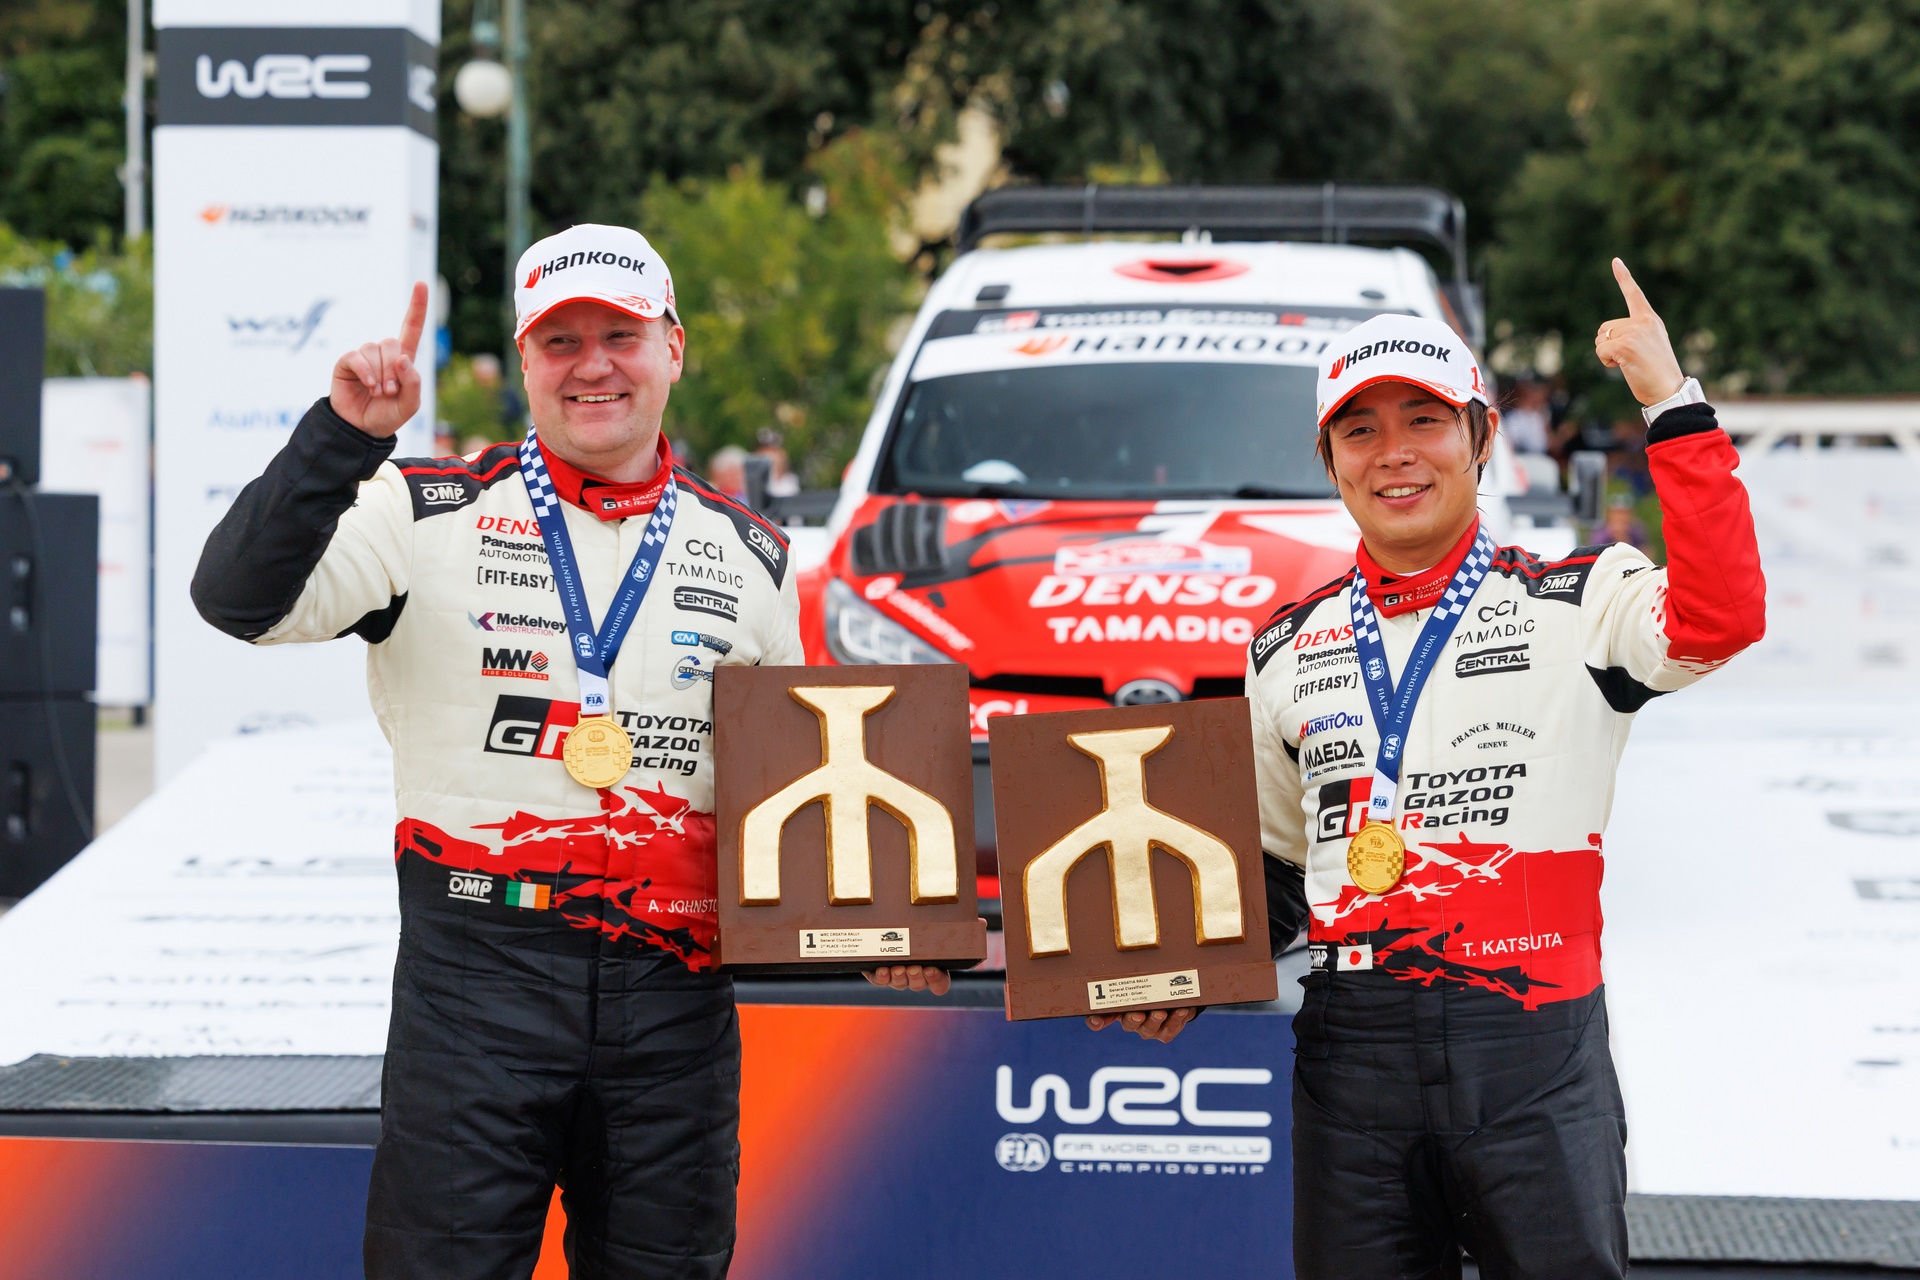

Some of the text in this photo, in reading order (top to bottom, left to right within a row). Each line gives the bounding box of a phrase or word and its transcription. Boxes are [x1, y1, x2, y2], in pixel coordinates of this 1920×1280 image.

[196, 55, 371, 98] WRC
[422, 486, 465, 501] OMP
[603, 499, 631, 510] GR
[476, 516, 542, 537] DENS
[552, 530, 564, 558] MEDAL
[748, 528, 780, 562] OMP
[479, 549, 551, 565] AUTOMOTIV
[667, 563, 743, 589] TAMADIC
[1539, 576, 1579, 592] OMP
[1028, 574, 1277, 608] DENSO
[1384, 593, 1413, 606] GR
[674, 594, 738, 615] CENTRAL
[496, 626, 554, 637] CONSTRUCTION
[497, 613, 567, 633] McKelvey
[1046, 615, 1254, 645] TAMADIC
[1455, 619, 1535, 648] TAMADIC
[1255, 620, 1292, 655] OMP
[1293, 623, 1354, 651] DENS
[1420, 634, 1438, 659] MEDAL
[483, 648, 532, 670] MW
[1298, 644, 1358, 665] Panasonic
[1455, 652, 1530, 673] CENTRAL
[503, 671, 548, 680] SOLUTIONS
[1295, 655, 1360, 676] AUTOMOTIVE
[586, 696, 604, 705] FIA
[616, 711, 712, 735] TOYOTA
[1451, 722, 1536, 748] FRANCK MULLER
[1477, 741, 1508, 750] GENEVE
[630, 753, 697, 776] acing
[1304, 739, 1365, 770] MAEDA
[1407, 763, 1527, 790] TOYOTA
[1373, 798, 1387, 807] FIA
[1404, 785, 1514, 810] GAZOO
[1401, 807, 1509, 830] Racing
[449, 877, 493, 897] OMP
[648, 899, 663, 913] A.
[806, 933, 816, 948] 1
[1462, 933, 1563, 957] T. KATSUTA
[1310, 950, 1328, 967] MP
[1095, 984, 1106, 1000] 1
[1170, 988, 1194, 997] WRC
[996, 1065, 1272, 1127] WRC
[1000, 1139, 1046, 1164] FIA
[1062, 1141, 1264, 1156] FIA WORLD RALLY
[1059, 1161, 1265, 1175] CHAMPIONSHIP
